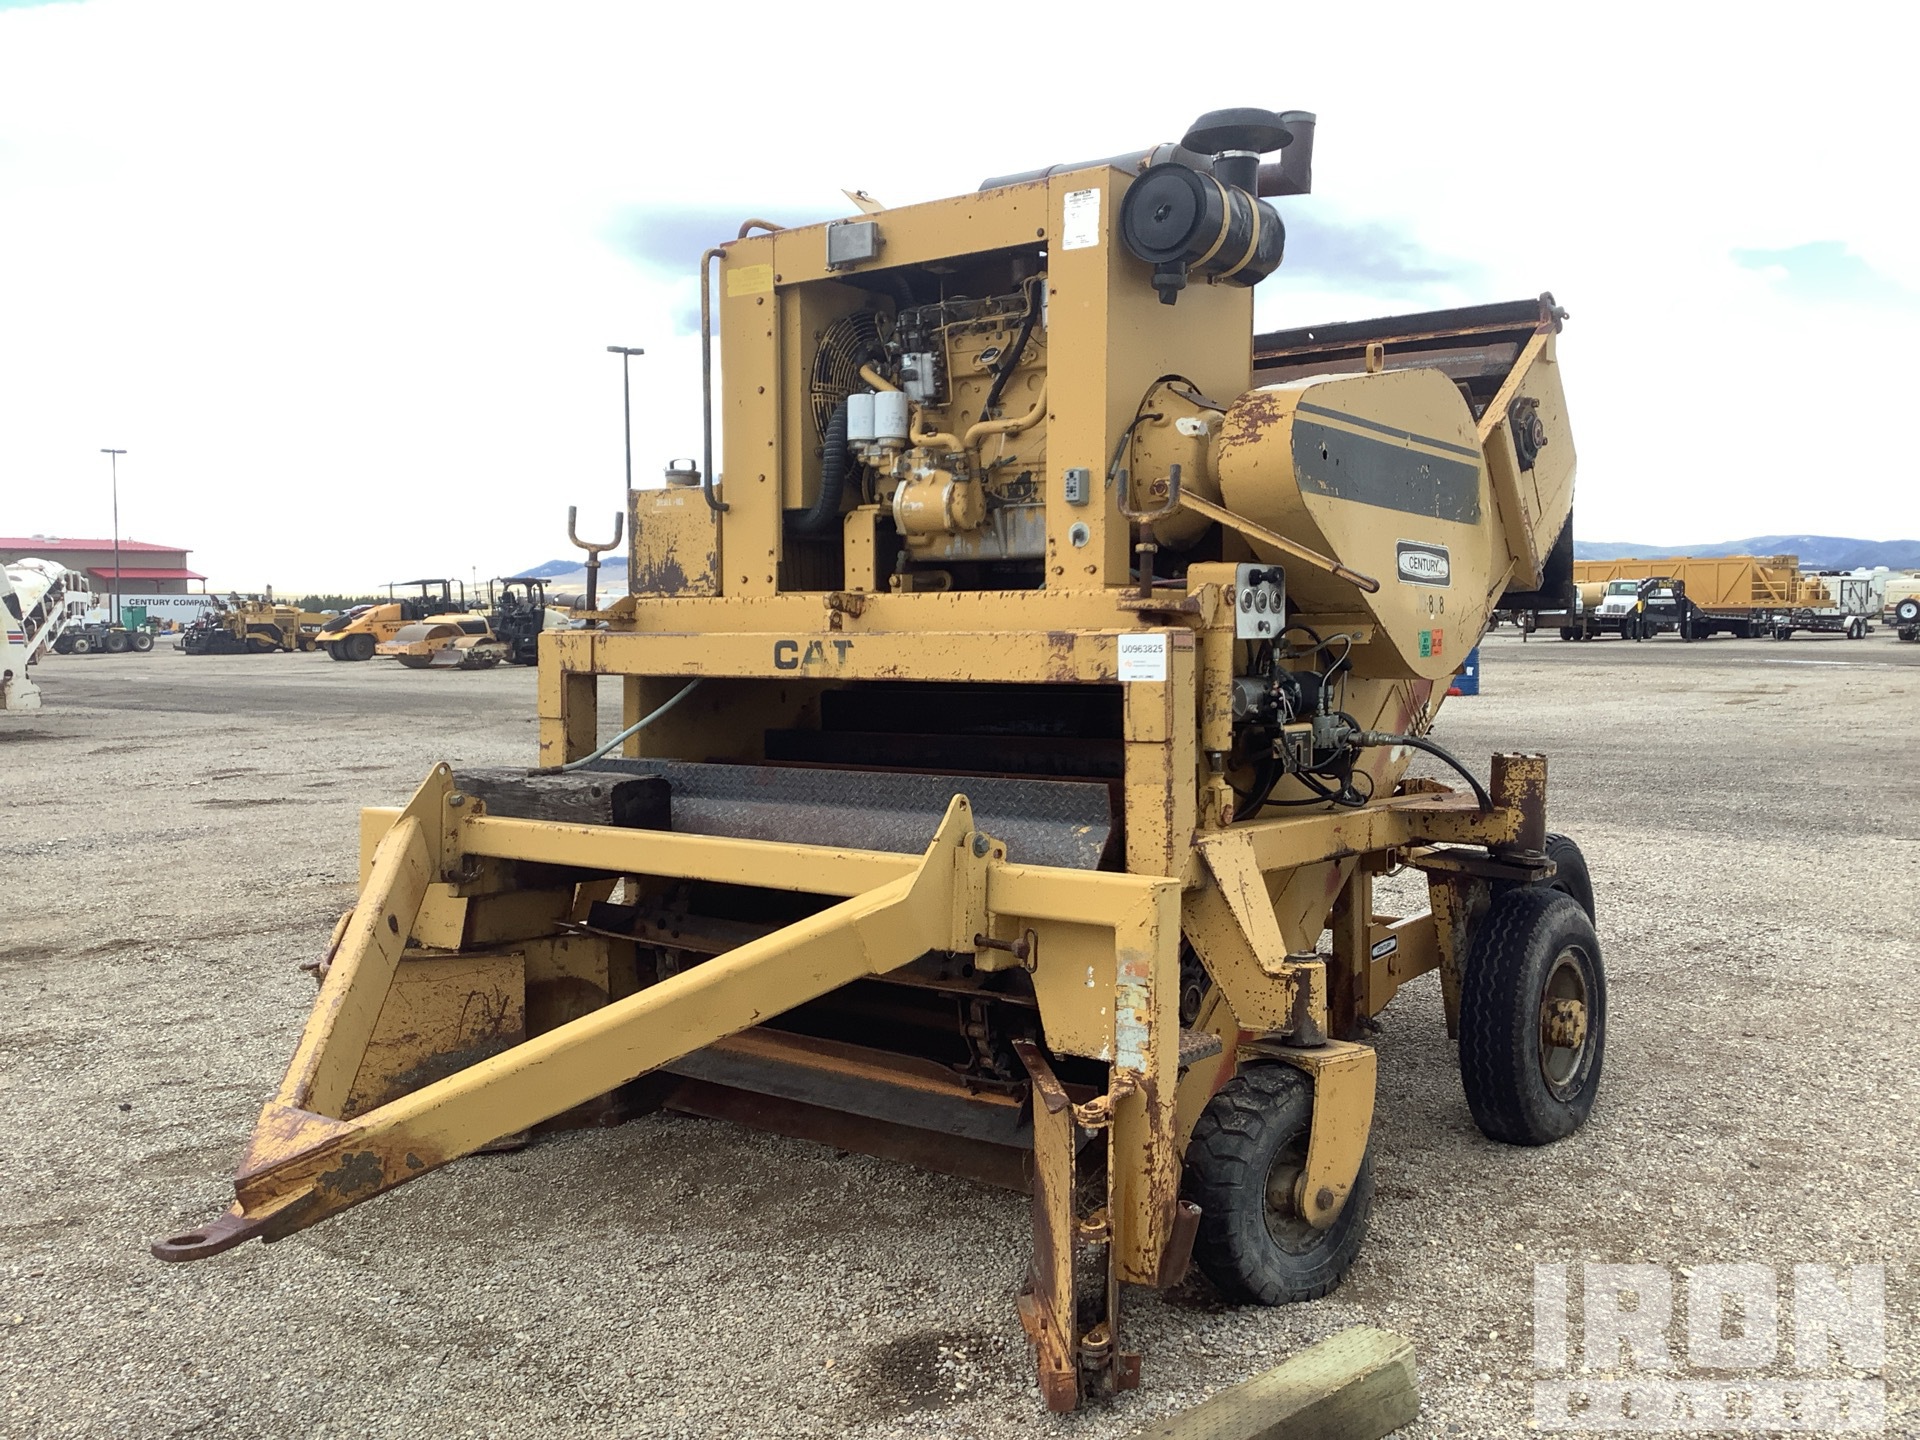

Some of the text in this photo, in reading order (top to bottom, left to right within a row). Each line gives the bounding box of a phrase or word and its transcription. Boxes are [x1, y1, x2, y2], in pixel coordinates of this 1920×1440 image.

[1409, 556, 1439, 572] CENTURY
[129, 598, 170, 606] CENTURY
[774, 639, 854, 670] CAT
[1121, 644, 1164, 654] U0963825
